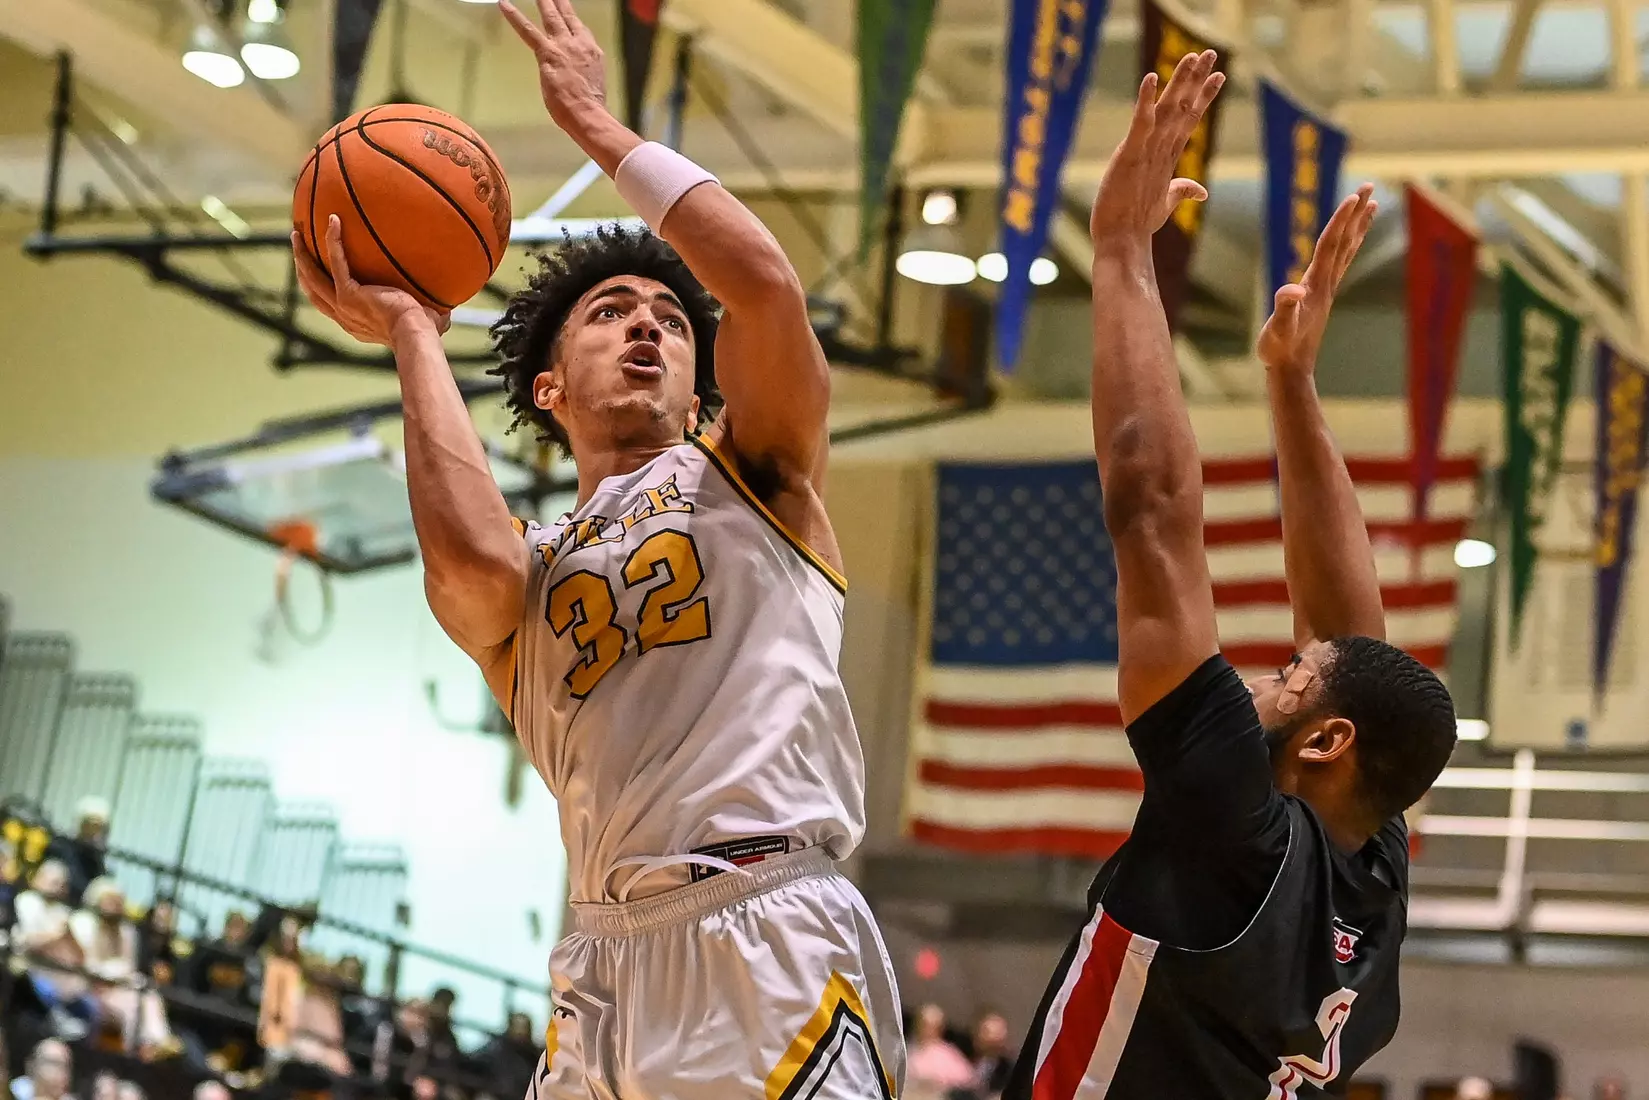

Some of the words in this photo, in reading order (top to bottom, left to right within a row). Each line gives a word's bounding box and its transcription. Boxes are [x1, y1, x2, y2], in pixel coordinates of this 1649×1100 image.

[545, 528, 712, 700] 32
[729, 848, 754, 857] UNDER
[754, 842, 783, 852] ARMOUR
